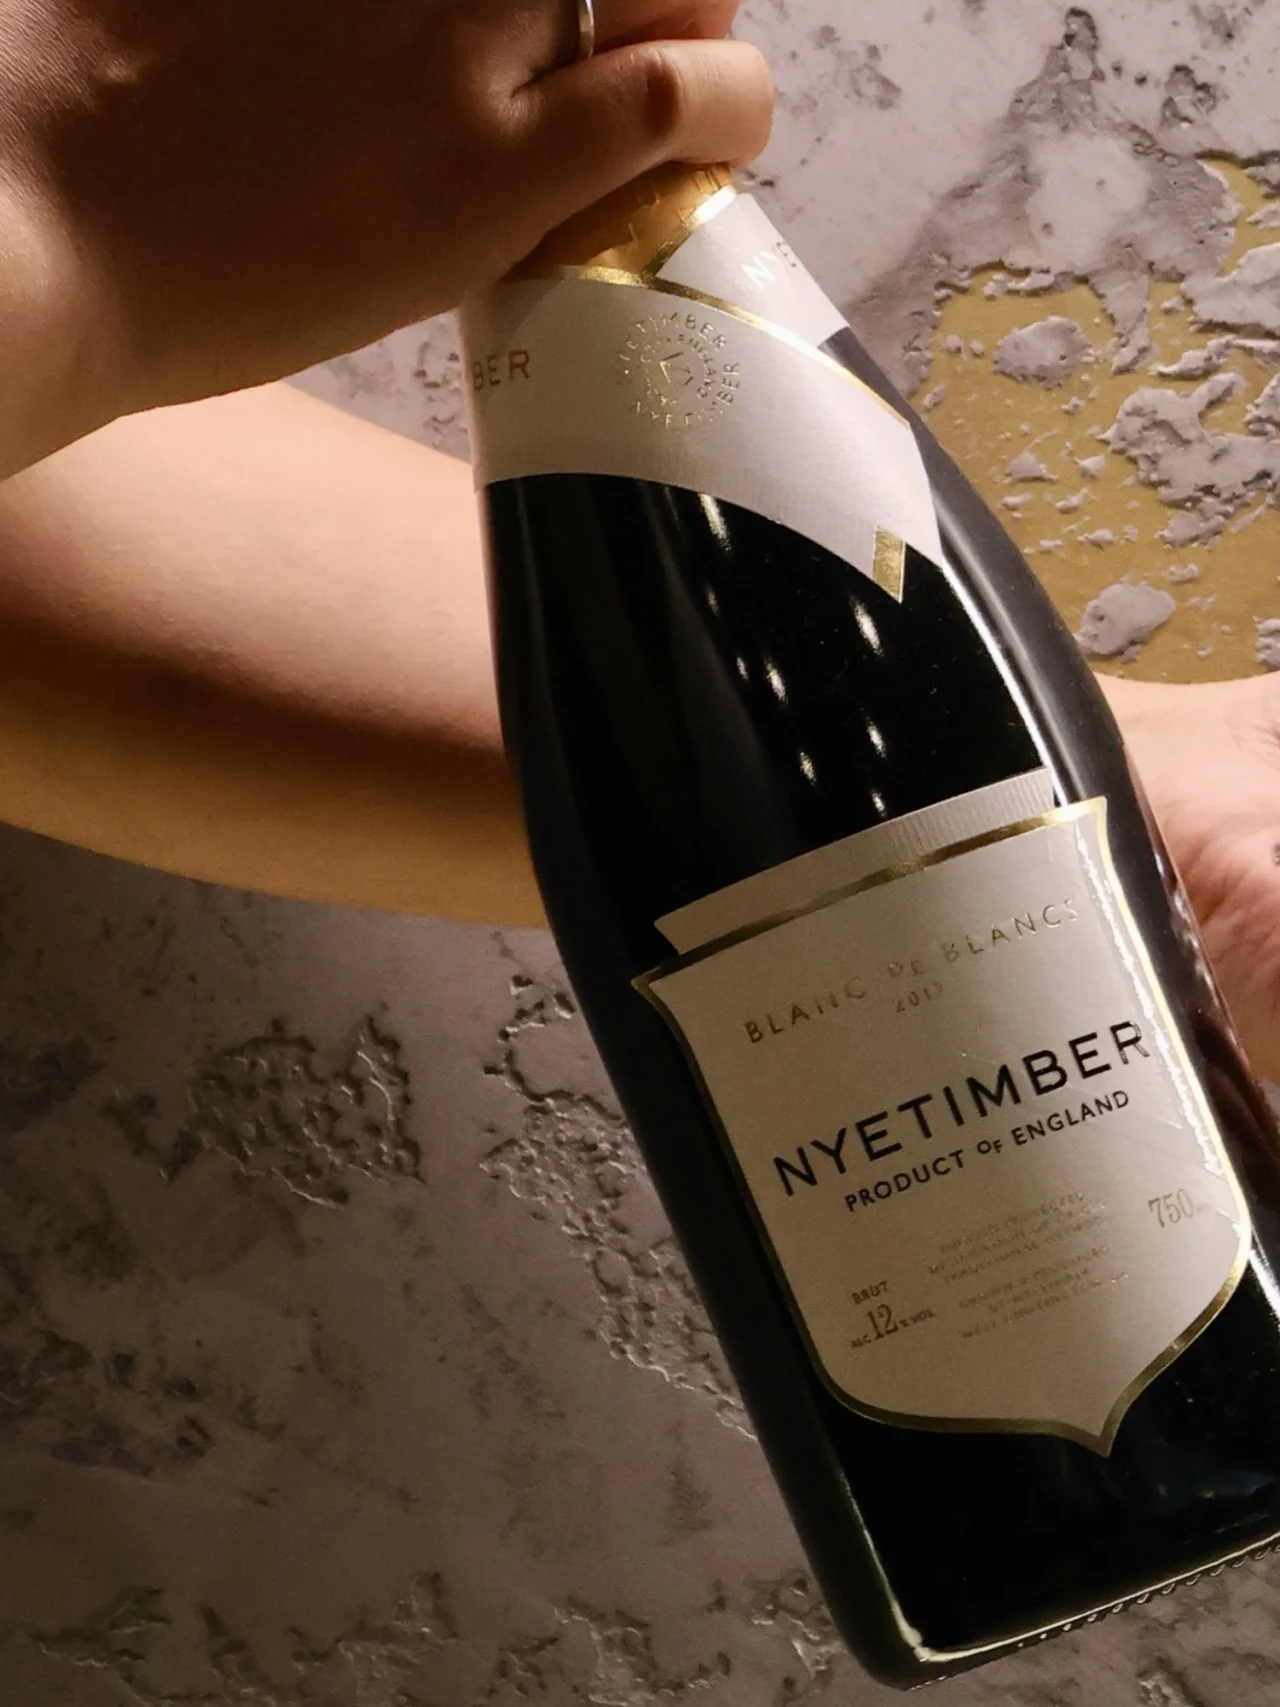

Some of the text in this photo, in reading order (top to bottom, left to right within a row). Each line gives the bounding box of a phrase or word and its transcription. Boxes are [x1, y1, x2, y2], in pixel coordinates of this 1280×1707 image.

[744, 897, 1081, 1044] BLANC DE BLANCS
[772, 1019, 1152, 1197] NYETIMBER
[844, 1088, 1131, 1213] PRODUCT OF ENGLAND
[1147, 1188, 1195, 1229] 750
